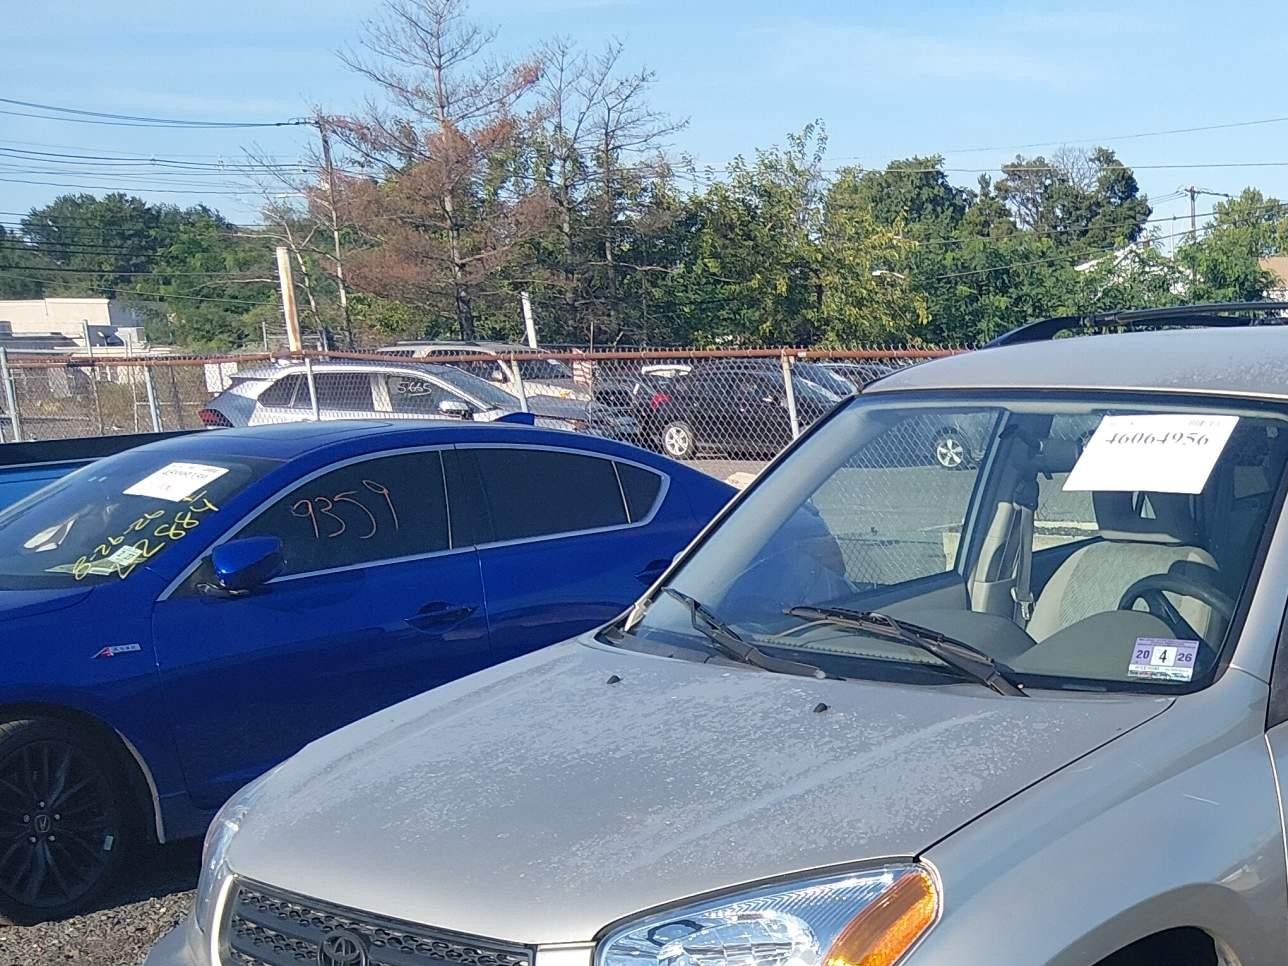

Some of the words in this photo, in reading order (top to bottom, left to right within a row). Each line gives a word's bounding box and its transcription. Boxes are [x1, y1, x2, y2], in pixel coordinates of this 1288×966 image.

[289, 480, 399, 538] 9359
[1136, 650, 1150, 659] 20
[1158, 649, 1167, 663] 4
[1177, 653, 1193, 662] 26
